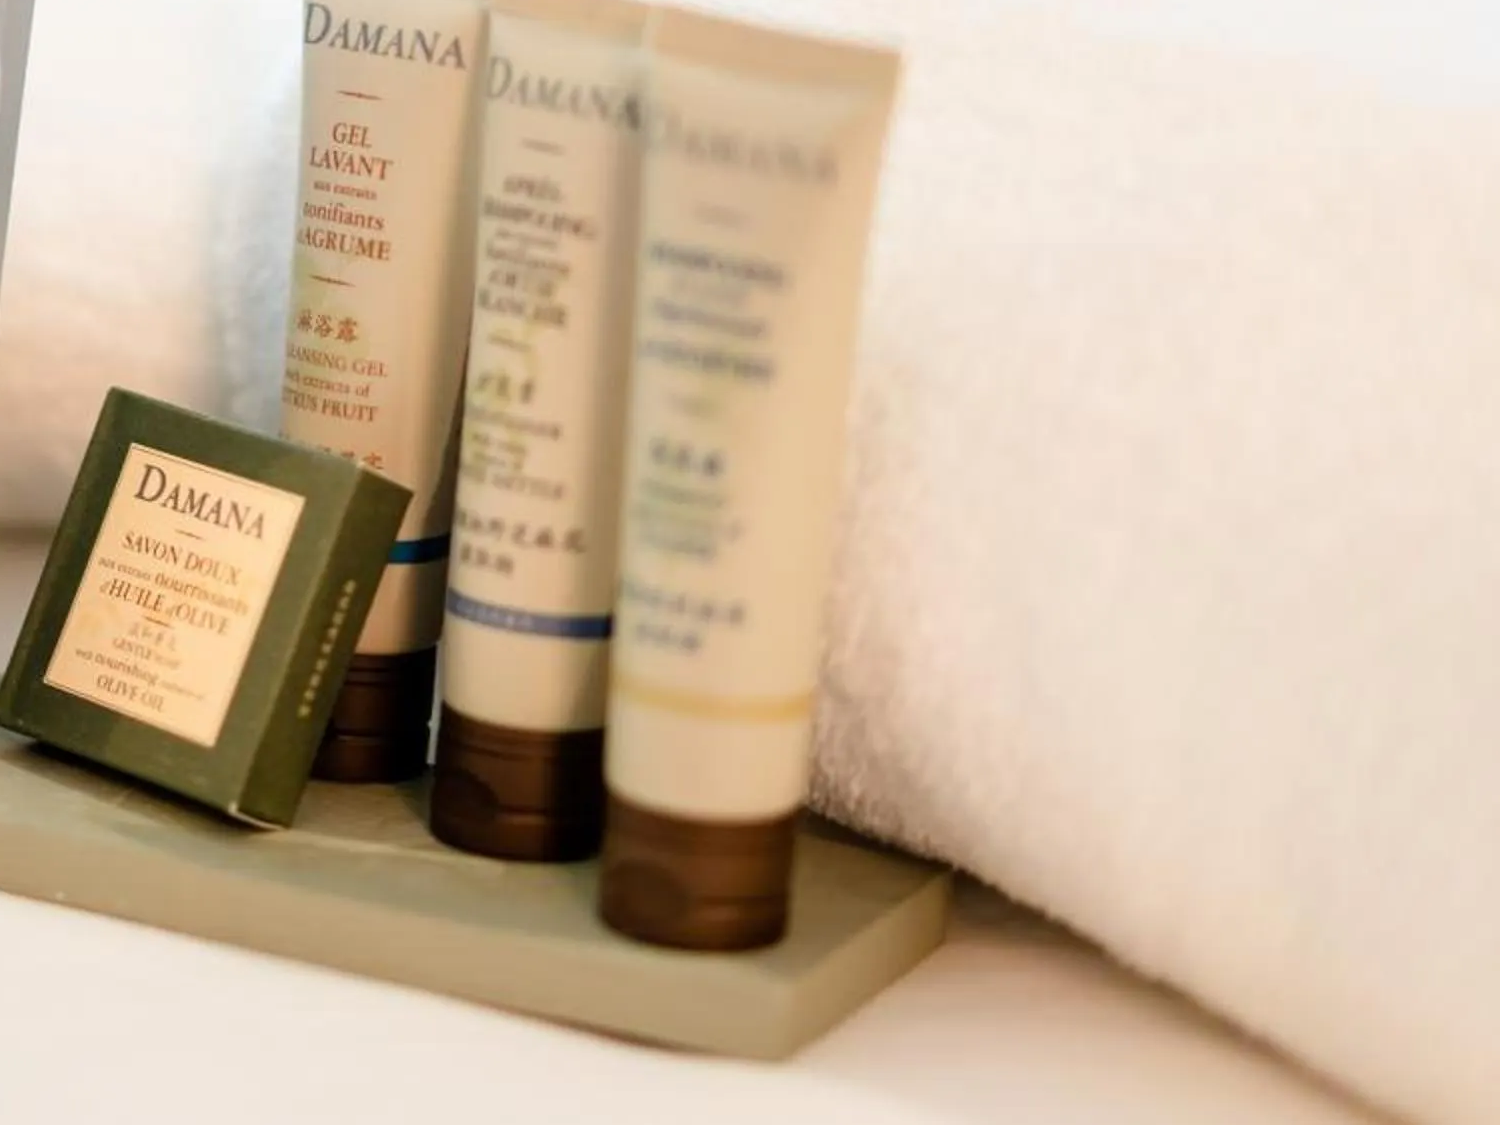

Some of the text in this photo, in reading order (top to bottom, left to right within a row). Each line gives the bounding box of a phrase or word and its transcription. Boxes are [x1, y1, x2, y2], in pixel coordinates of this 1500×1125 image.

[304, 2, 467, 70] DAMANA
[332, 122, 372, 149] GEL
[309, 146, 394, 181] LAVANT
[302, 202, 385, 231] tonifiants
[352, 358, 389, 378] GEL
[321, 398, 380, 423] FRUIT
[134, 463, 265, 540] DAMANA
[121, 530, 242, 586] SAVON DOUX
